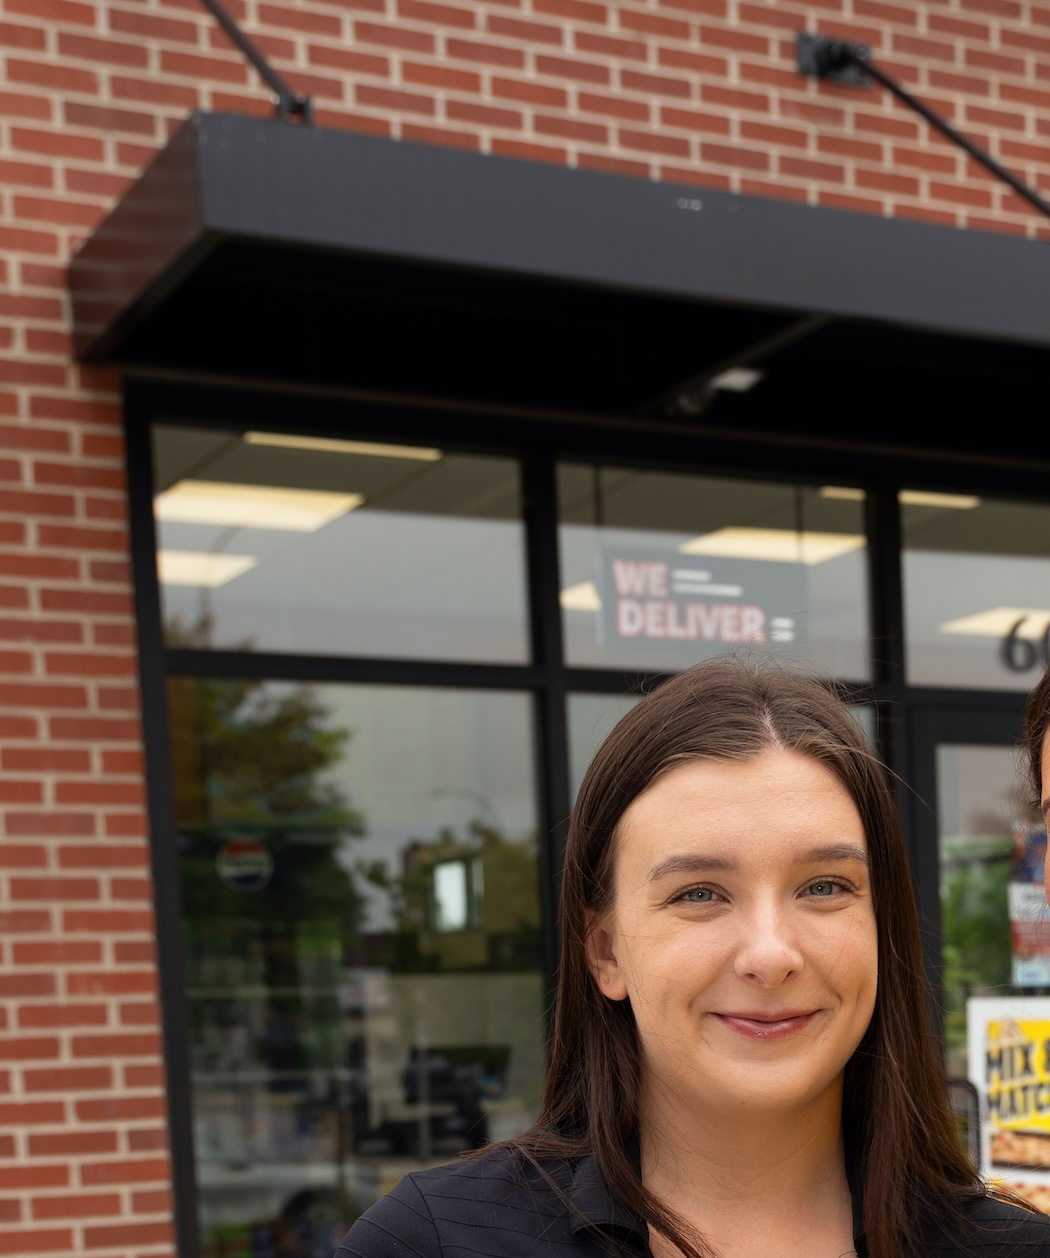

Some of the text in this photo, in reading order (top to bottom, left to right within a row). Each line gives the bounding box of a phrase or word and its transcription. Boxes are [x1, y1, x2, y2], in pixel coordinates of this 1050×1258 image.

[612, 559, 669, 597] WE
[616, 598, 767, 644] DELIVER
[986, 1043, 1035, 1086] MIX
